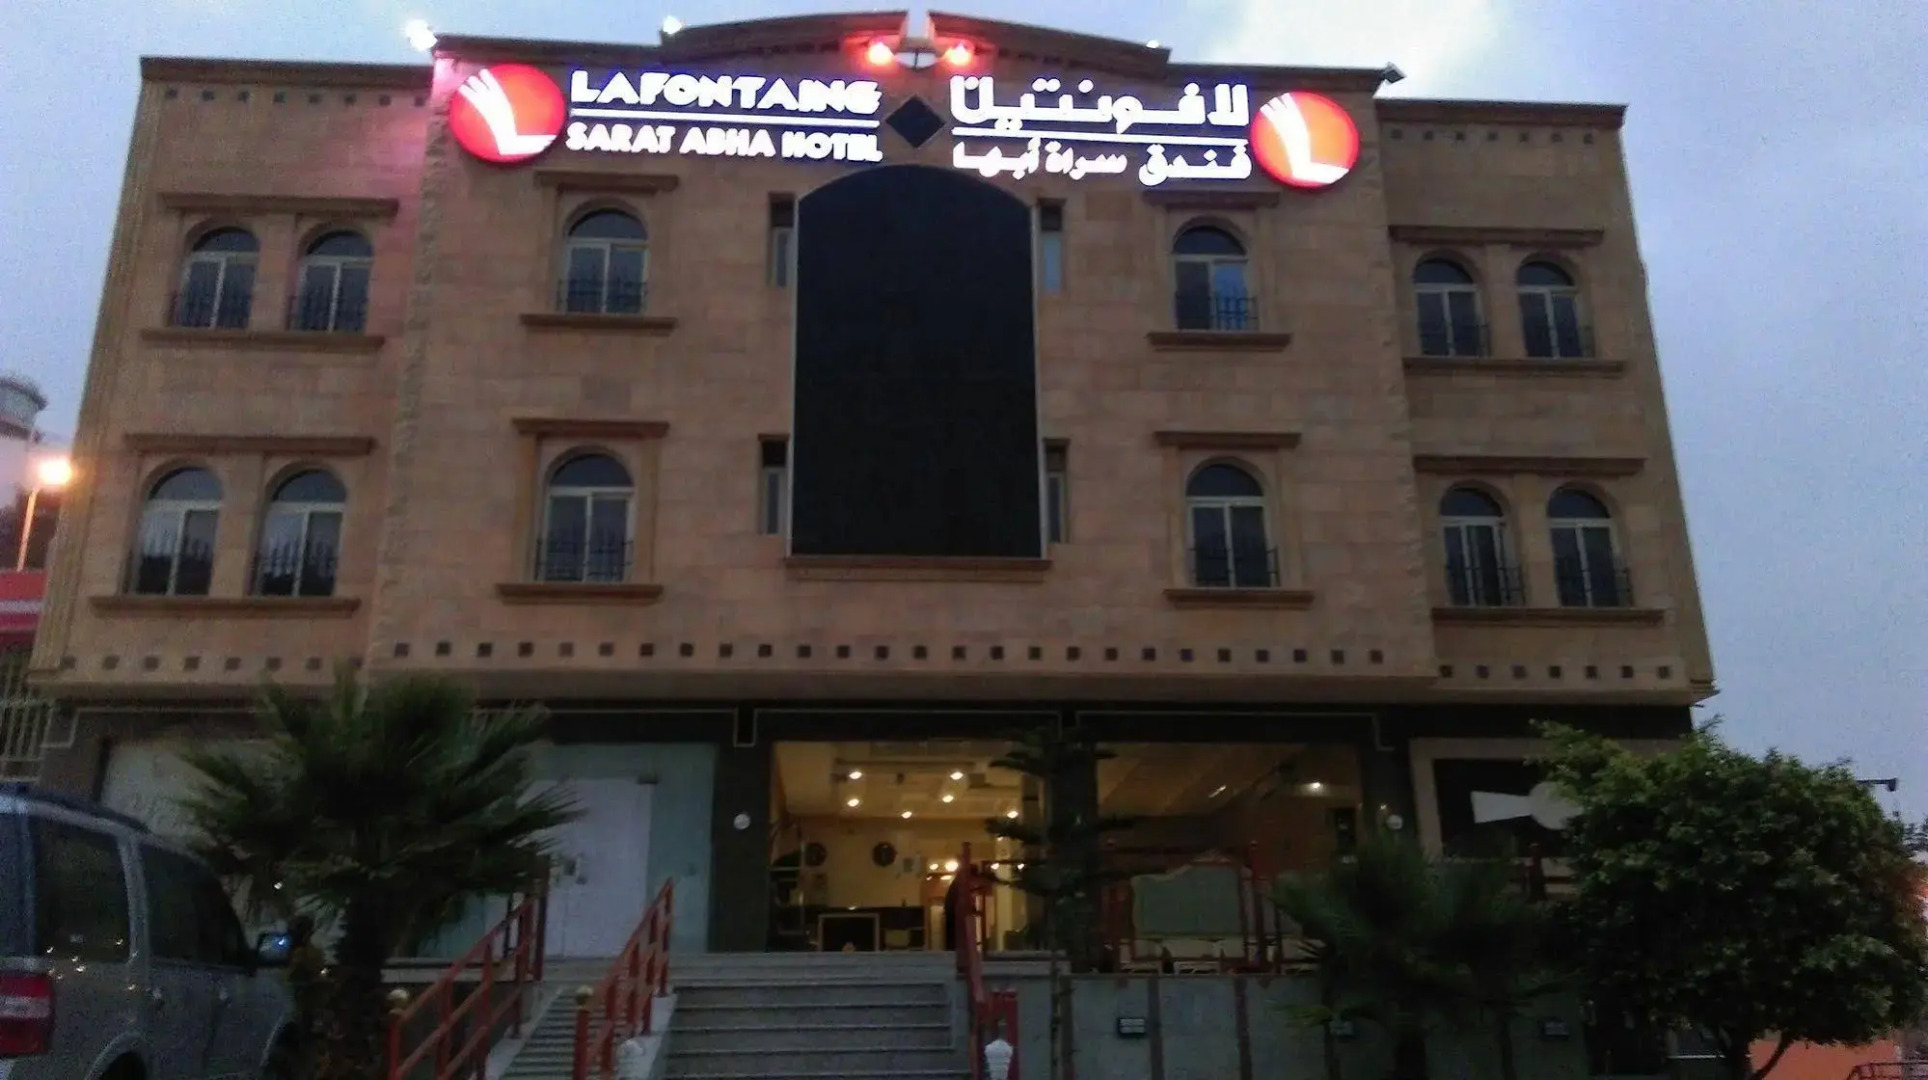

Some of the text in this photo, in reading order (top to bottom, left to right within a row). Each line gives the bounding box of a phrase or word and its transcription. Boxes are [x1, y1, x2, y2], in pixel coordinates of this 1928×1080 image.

[570, 70, 882, 114] LAFONTAINE
[565, 121, 883, 162] SARAT ABHA HOTEL
[1138, 144, 1252, 186] فندق
